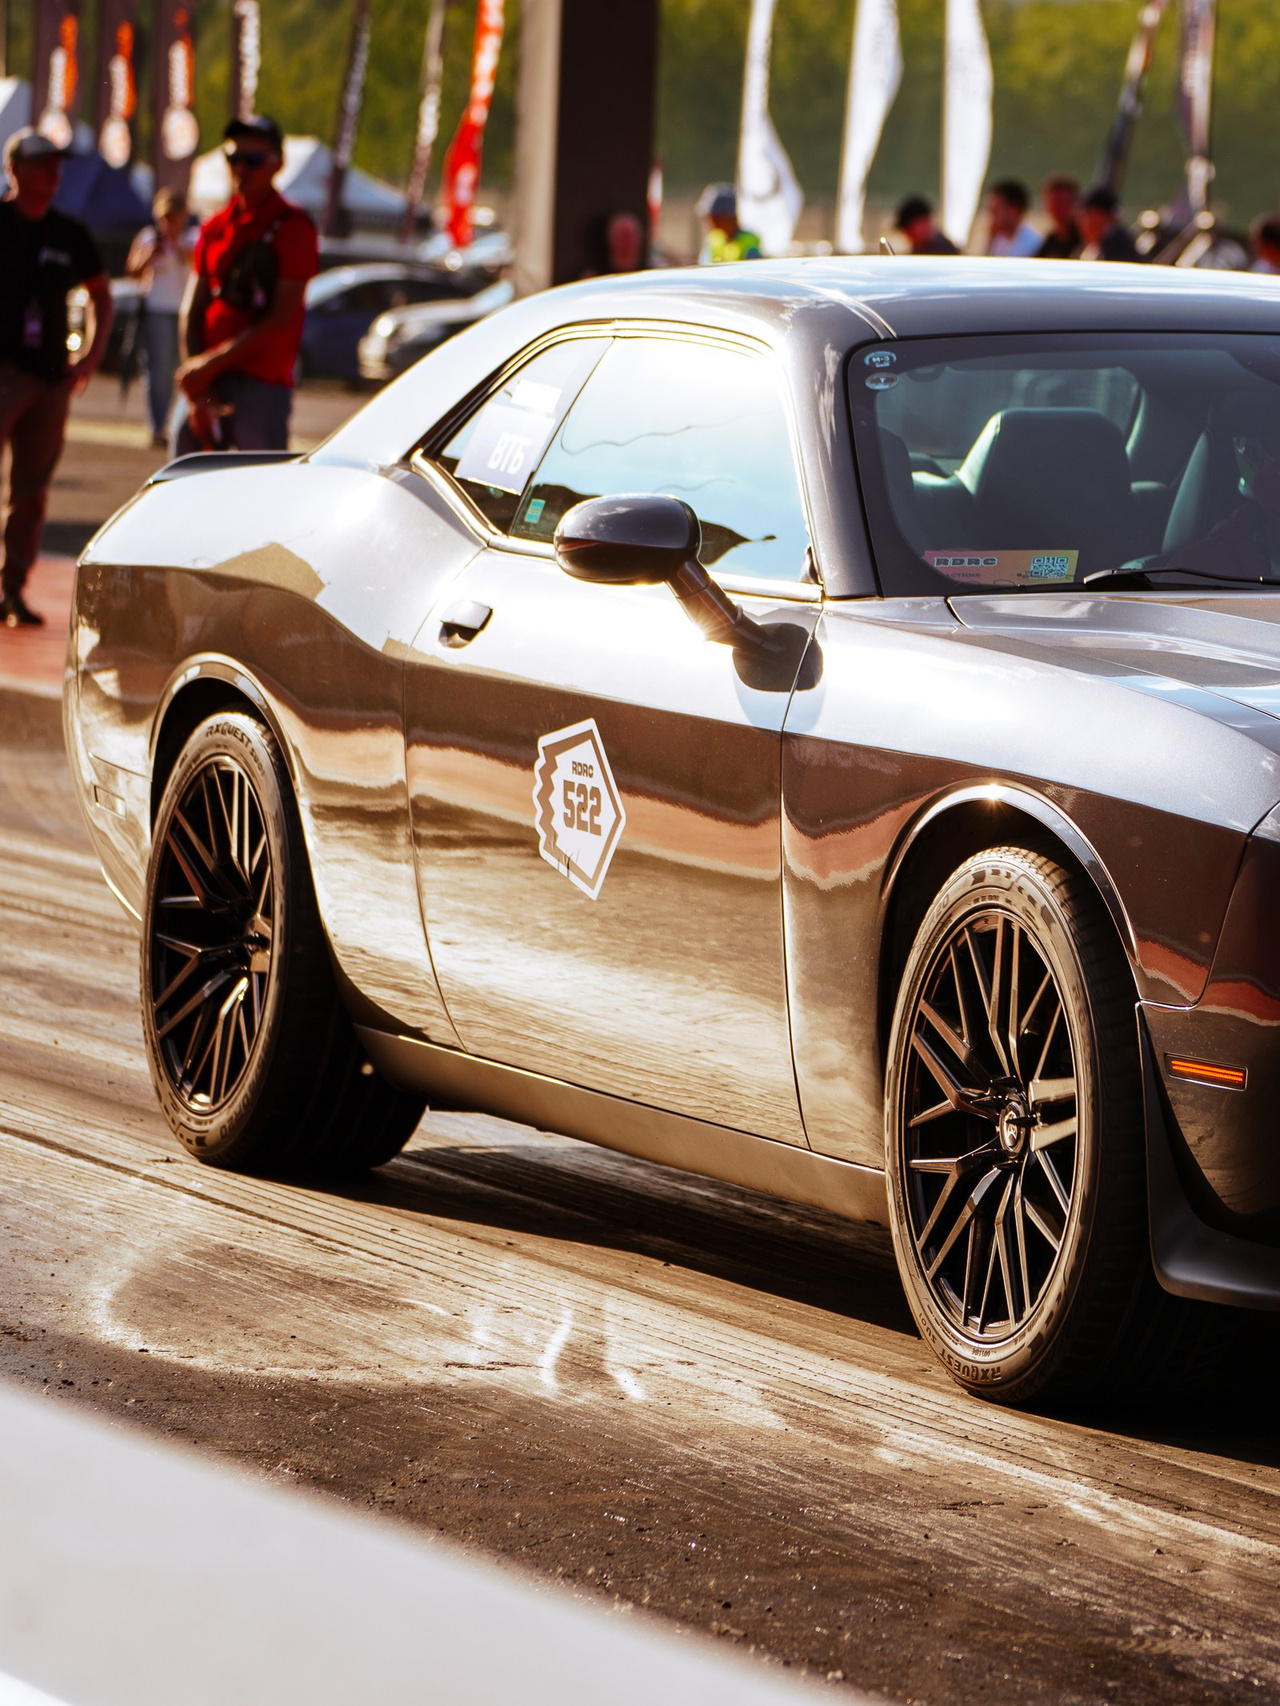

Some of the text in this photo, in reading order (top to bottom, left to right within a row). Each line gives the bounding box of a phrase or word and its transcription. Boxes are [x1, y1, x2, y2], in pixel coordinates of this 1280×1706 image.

[935, 556, 998, 567] RDRC
[571, 760, 594, 779] RDRC
[563, 779, 602, 837] 522
[939, 1347, 1003, 1382] RXQUEST
